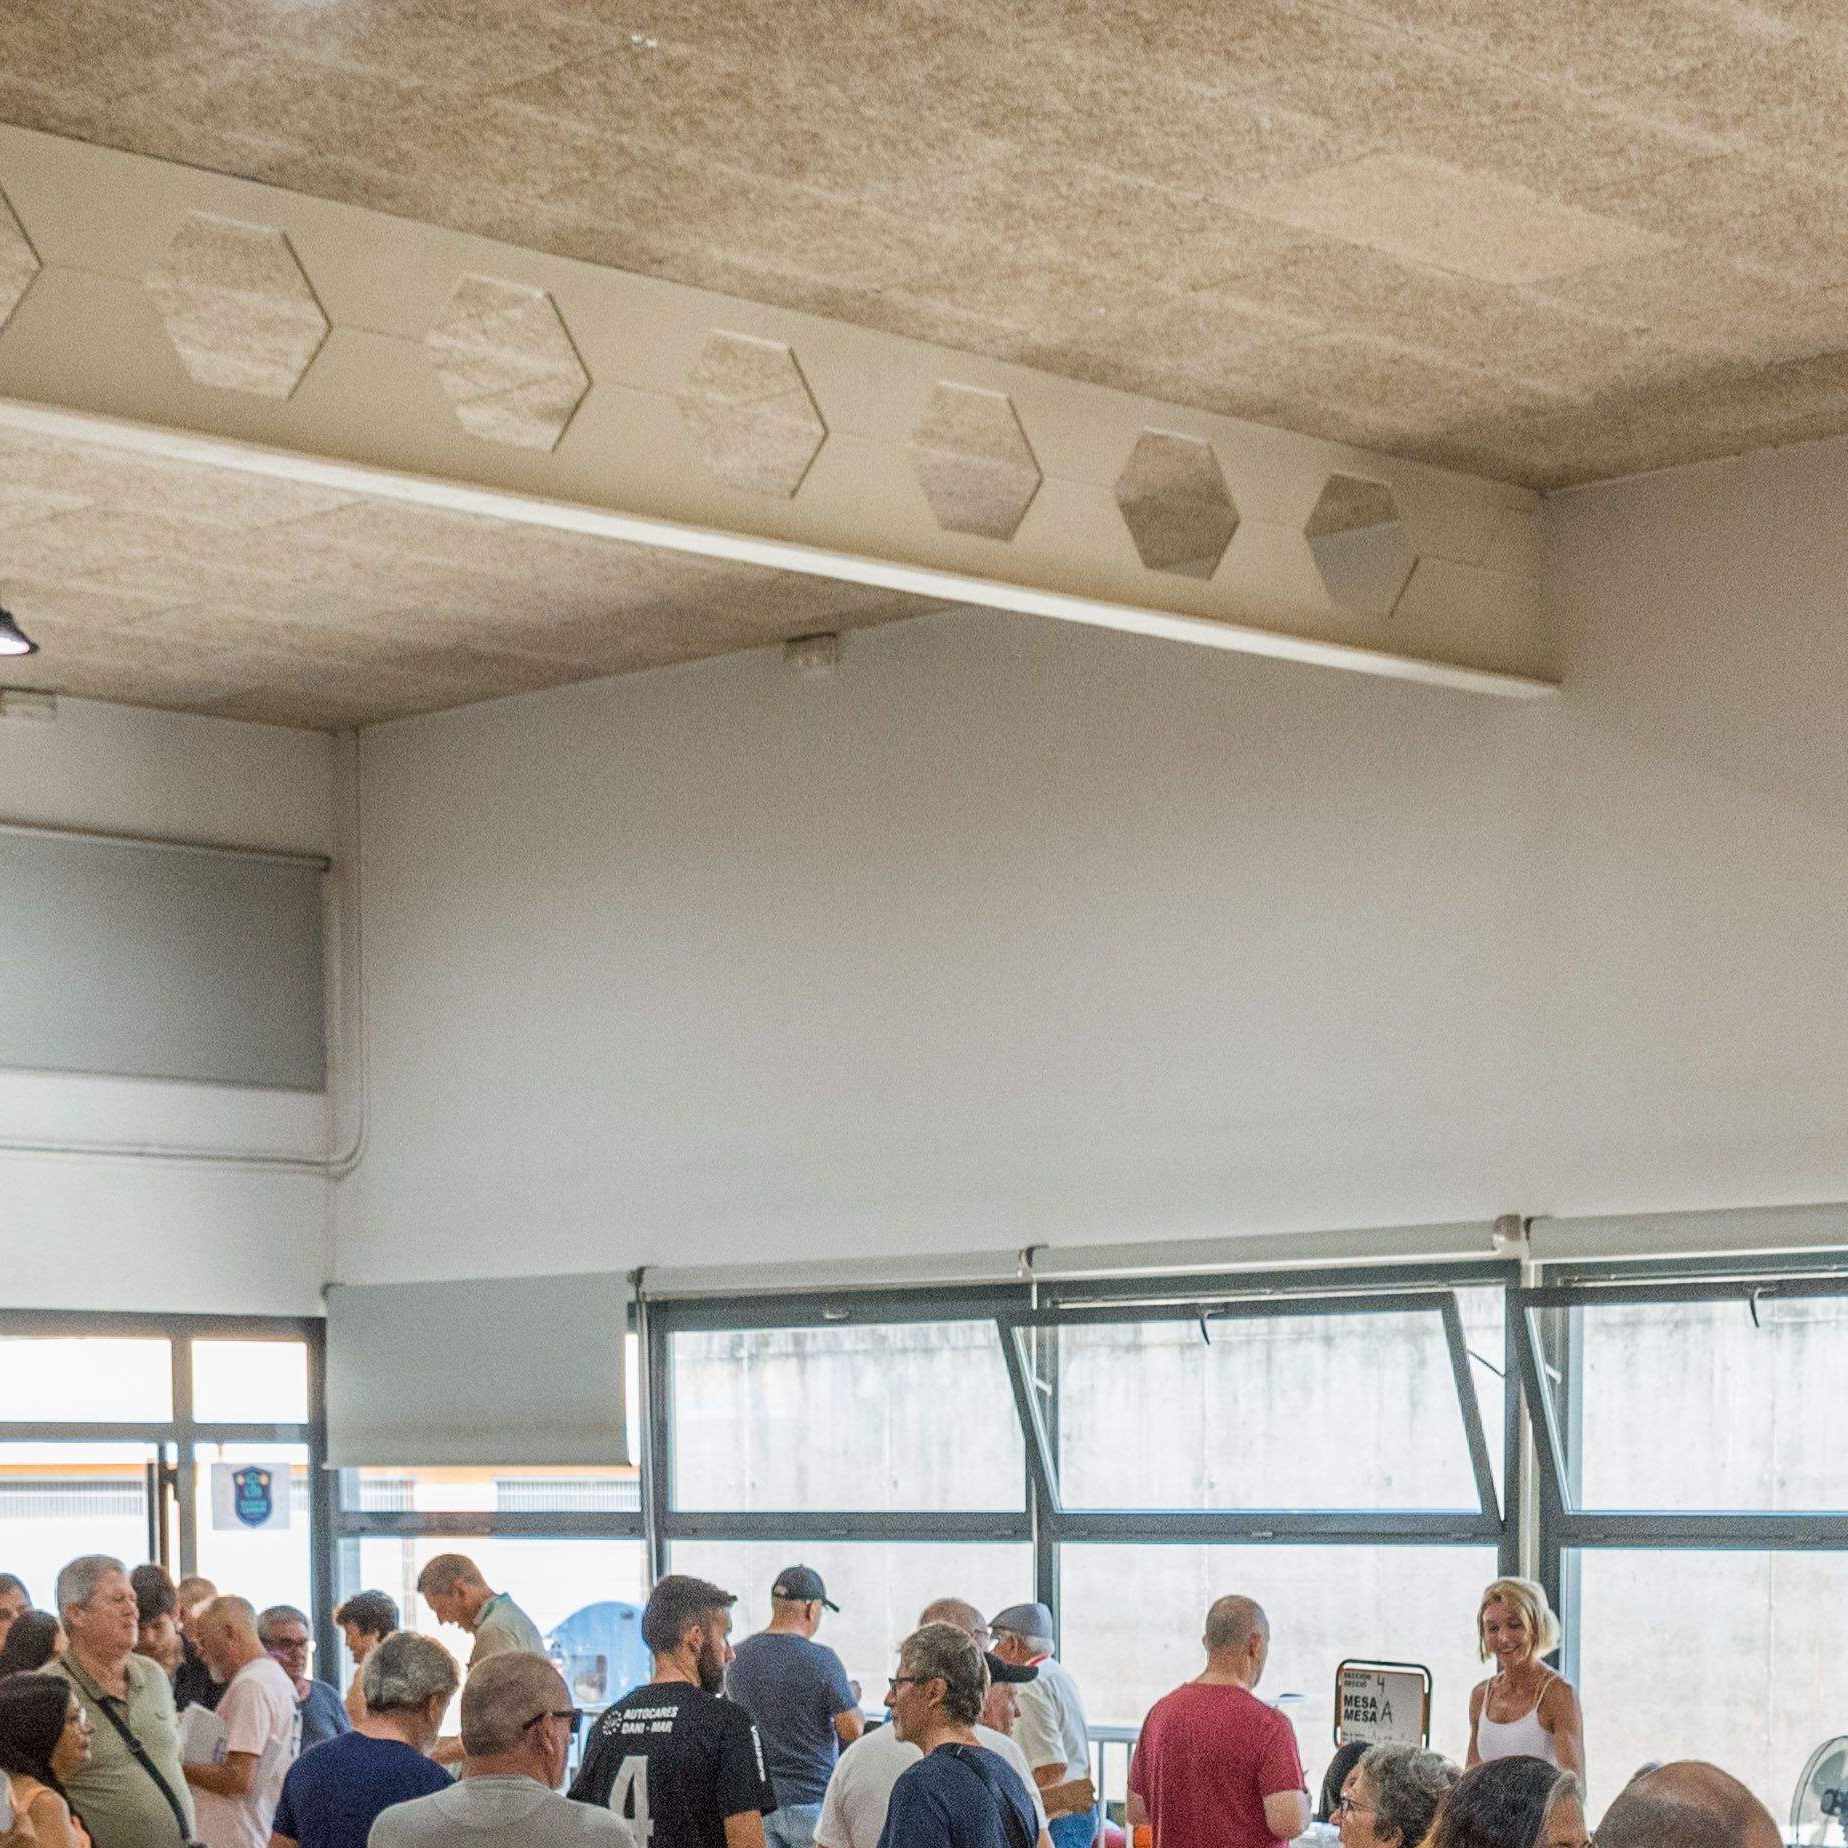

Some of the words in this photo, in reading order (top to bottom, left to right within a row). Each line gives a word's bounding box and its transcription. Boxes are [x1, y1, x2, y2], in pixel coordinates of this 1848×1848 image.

[1377, 1674, 1386, 1694] 4
[1343, 1695, 1378, 1709] MESA
[623, 1706, 679, 1720] AUTOCARES
[1343, 1709, 1378, 1723] MESA
[1381, 1701, 1393, 1724] A
